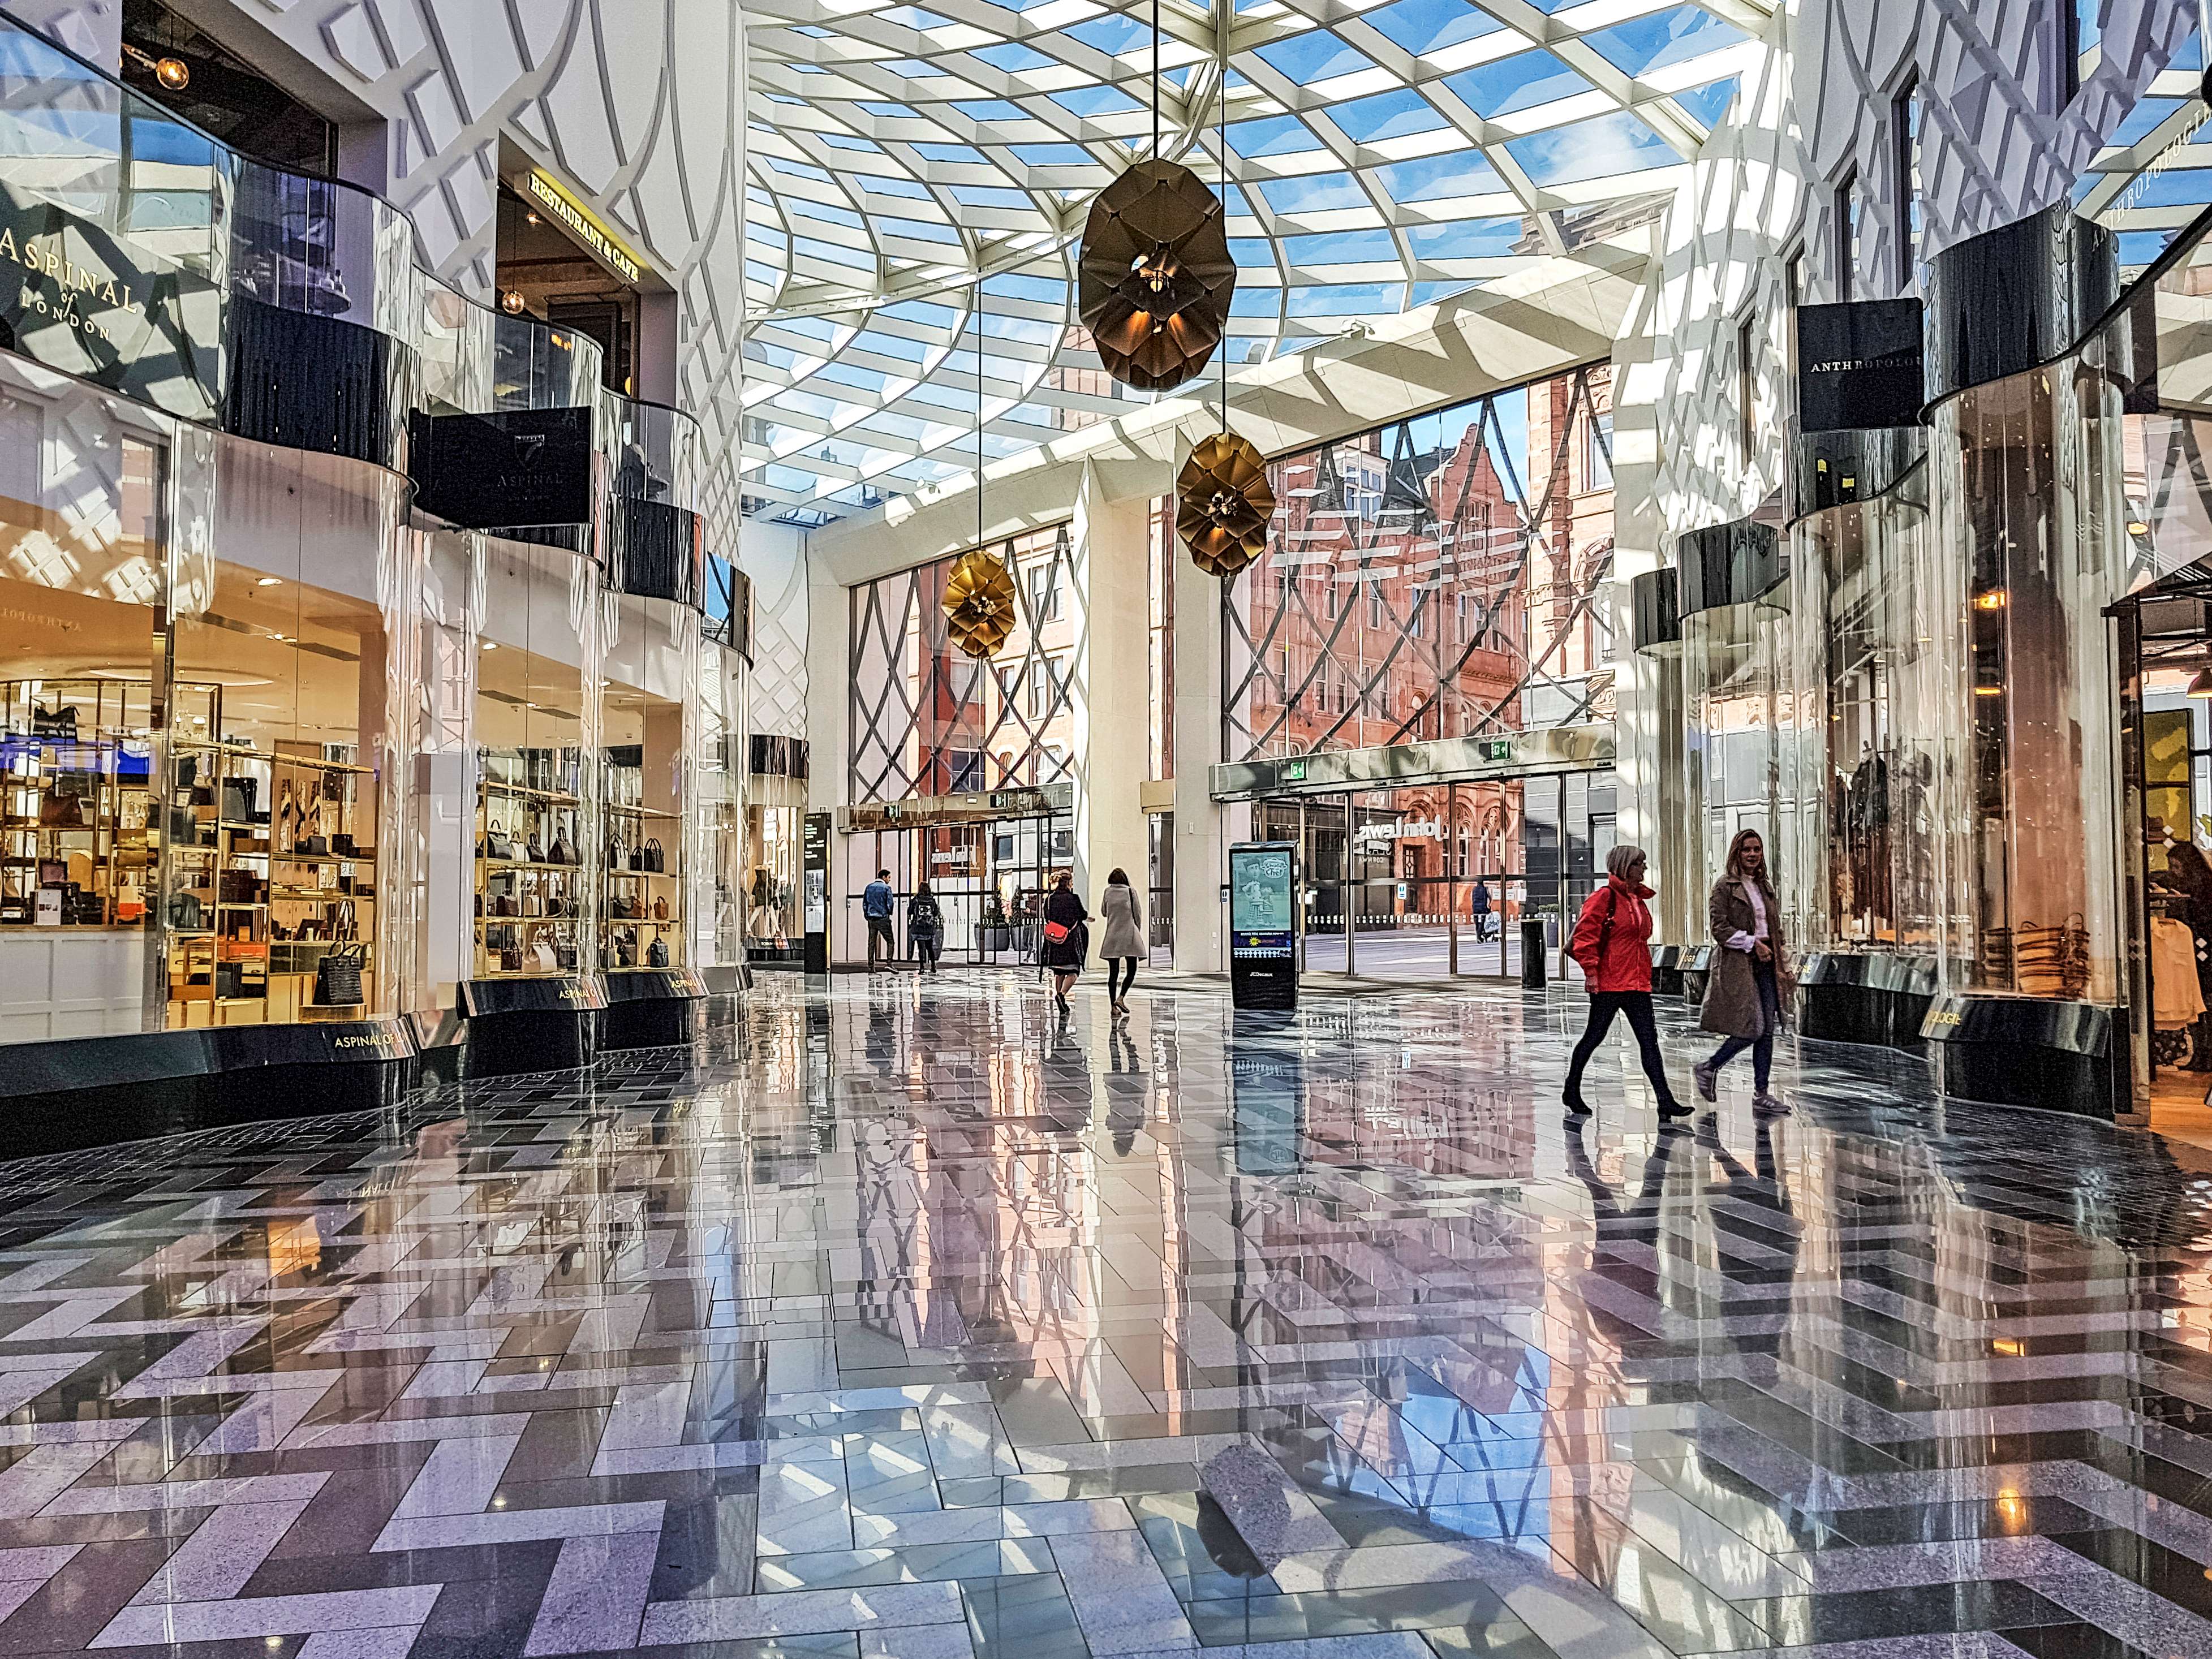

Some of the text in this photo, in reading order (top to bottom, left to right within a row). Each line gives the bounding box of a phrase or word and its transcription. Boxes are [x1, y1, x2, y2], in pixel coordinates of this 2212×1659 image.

[531, 173, 604, 253] RESTAURANT
[603, 240, 612, 258] &
[0, 227, 137, 314] ASPINAL
[21, 292, 110, 341] LONDON
[61, 291, 78, 318] of
[335, 1035, 382, 1048] ASPINAL
[382, 1033, 394, 1044] OF
